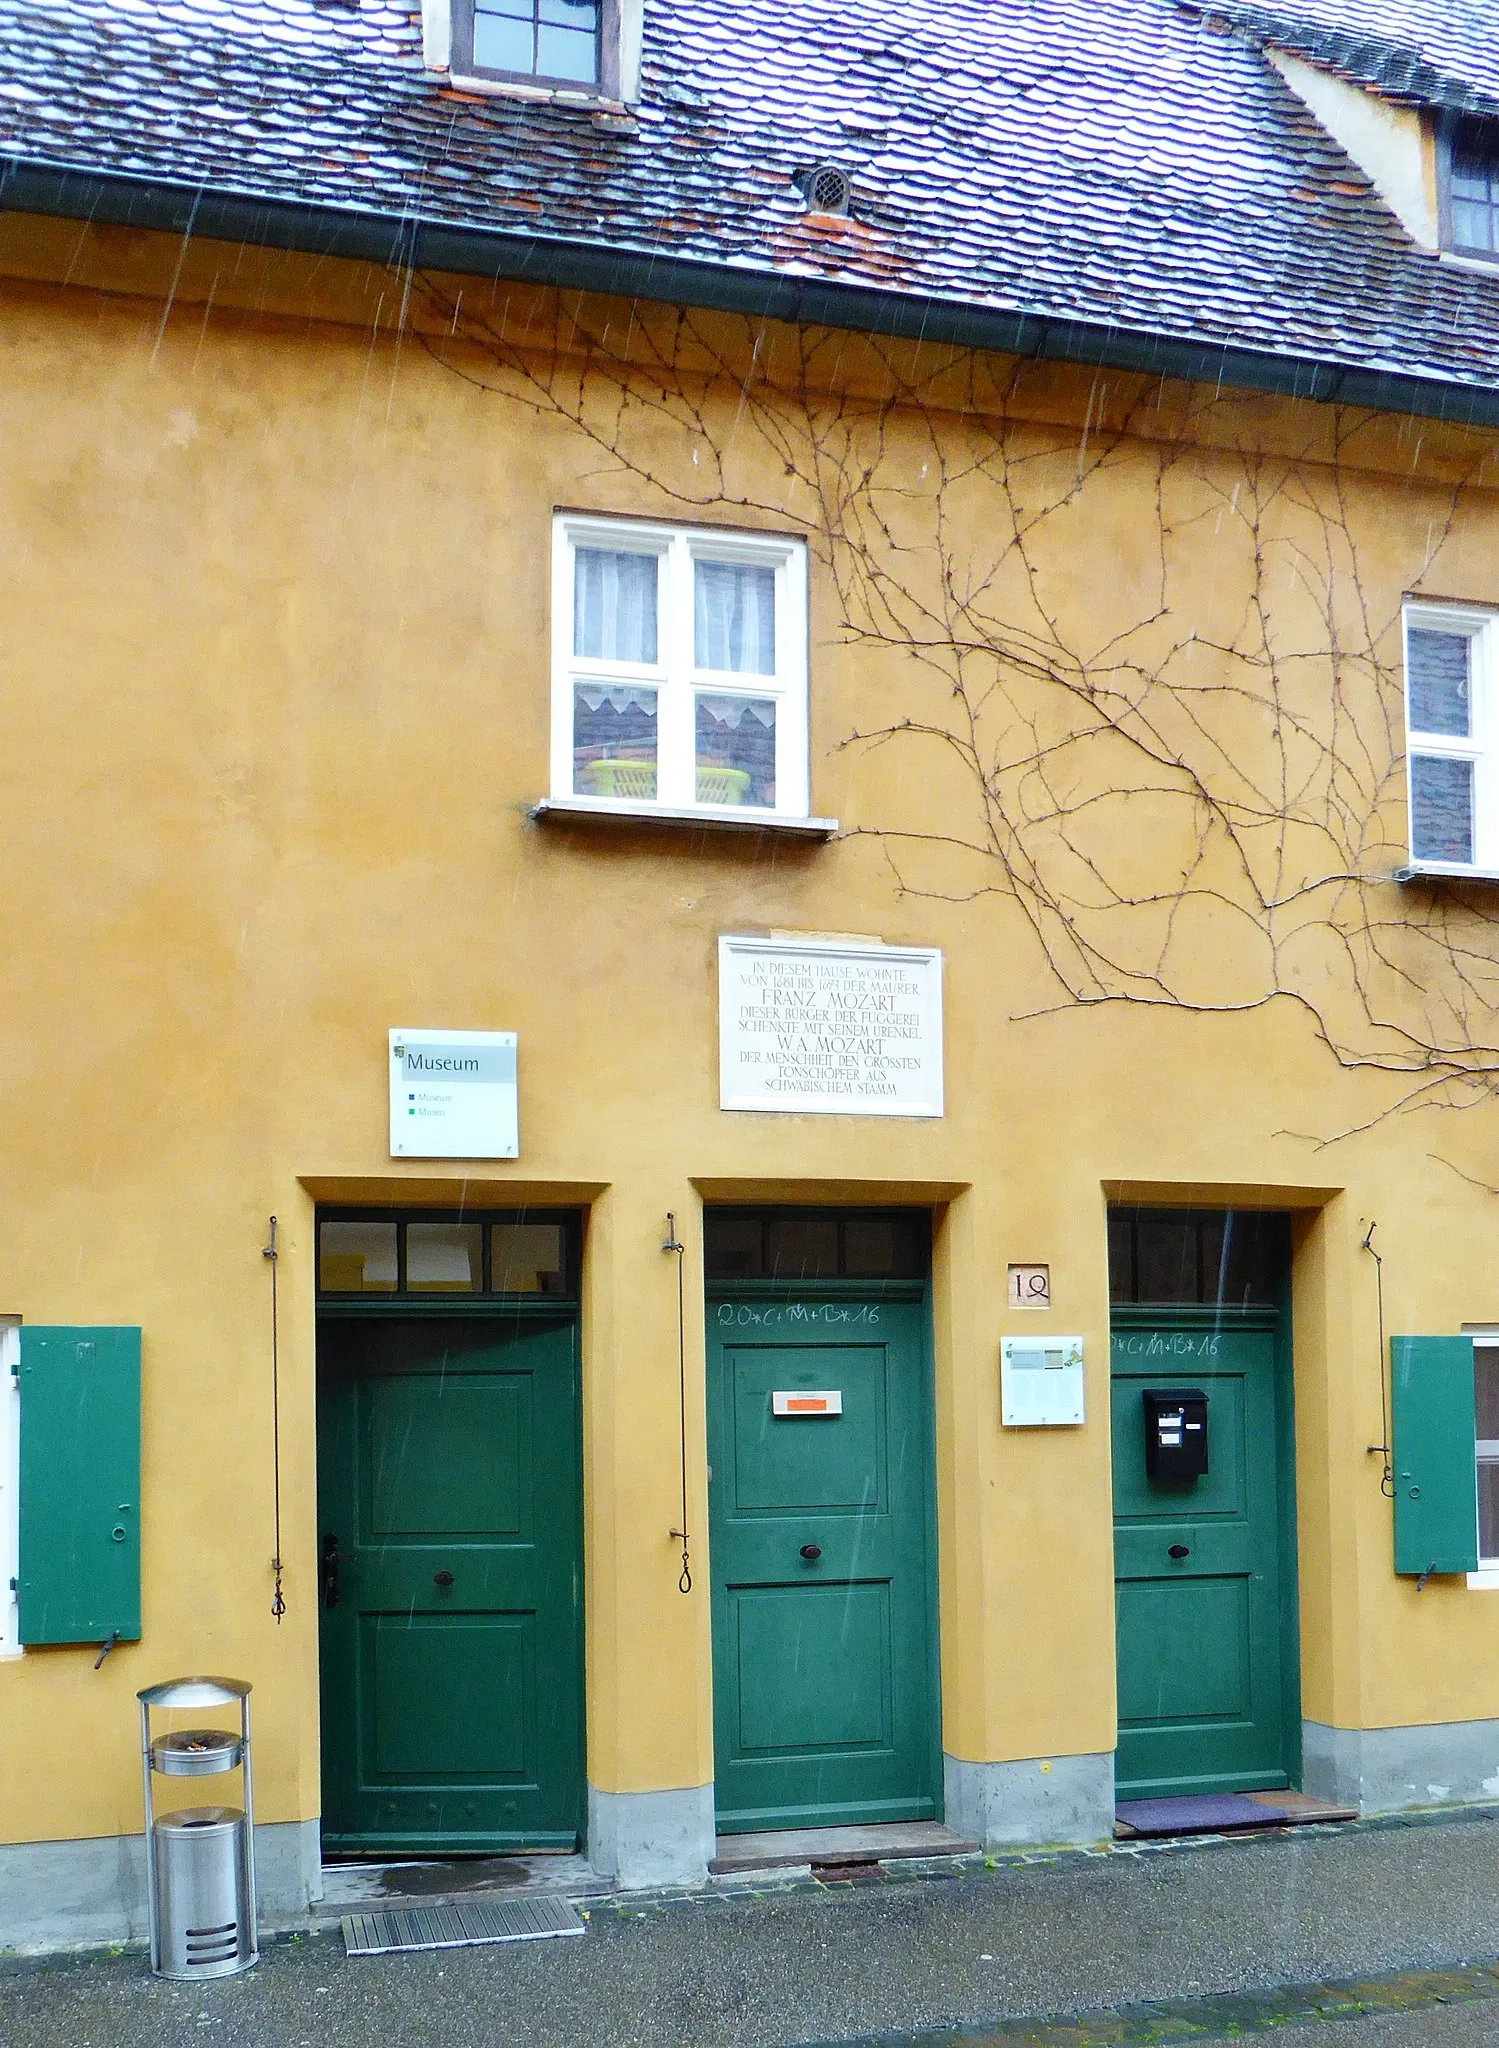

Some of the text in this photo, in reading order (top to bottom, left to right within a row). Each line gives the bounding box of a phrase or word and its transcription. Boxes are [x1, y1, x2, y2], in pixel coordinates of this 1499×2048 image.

[753, 961, 907, 981] IN DIESEM HAUSE WOHNTE
[740, 974, 920, 995] VON 1681 BIS 1693 DER MAURER
[762, 988, 897, 1011] FRANZ MOZART
[740, 1005, 780, 1019] DIESER
[835, 1010, 858, 1023] DER
[861, 1011, 920, 1026] FUGGEREI
[738, 1019, 800, 1034] SCHENKTE
[803, 1022, 824, 1035] MIT
[828, 1023, 869, 1036] SEINEM
[815, 1036, 887, 1055] MOZART
[407, 1053, 479, 1071] Museum
[740, 1050, 761, 1063] DER
[766, 1052, 833, 1066] MENSCHHEIT
[838, 1055, 859, 1067] DEN
[866, 1069, 887, 1082] AUS
[857, 1082, 898, 1095] STAMM
